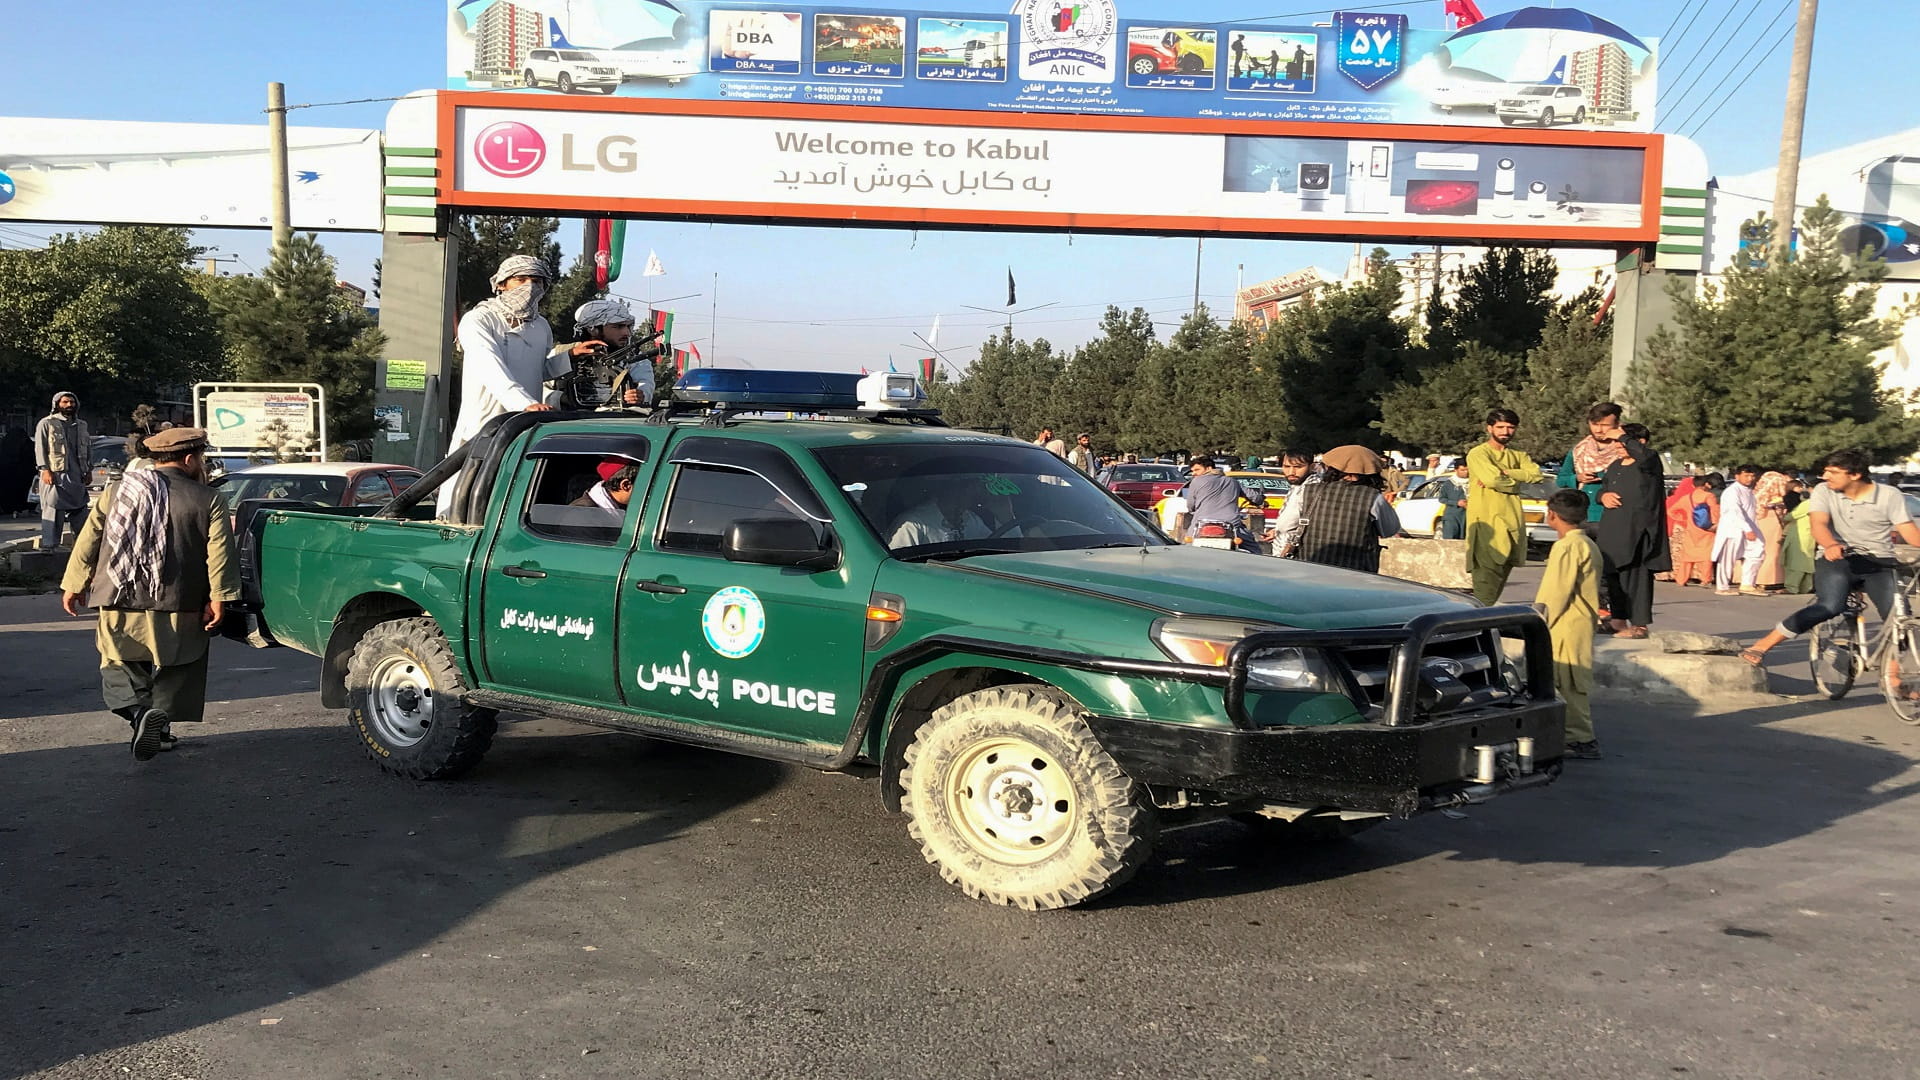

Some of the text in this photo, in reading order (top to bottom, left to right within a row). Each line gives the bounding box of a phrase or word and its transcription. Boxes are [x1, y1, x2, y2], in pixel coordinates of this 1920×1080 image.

[736, 32, 774, 44] DBA
[1350, 29, 1392, 54] ۵۷
[735, 60, 755, 69] DBA
[1346, 57, 1392, 68] سال خدمت
[828, 64, 890, 74] بیمه آتش سوزی
[927, 67, 997, 79] بیمه اموال تجارتی
[1049, 64, 1085, 76] ANIC
[1147, 76, 1194, 87] بیمه موتر
[1250, 81, 1294, 90] بیمه سفر
[1048, 85, 1064, 94] ملی
[1067, 86, 1084, 94] بیمه
[1086, 86, 1112, 96] شرکت
[775, 131, 1049, 161] Welcome to Kabul
[562, 133, 637, 173] LG
[773, 161, 1051, 198] به کابل خوش آمدید
[501, 608, 517, 629] کابل
[637, 650, 719, 709] پولیس
[732, 678, 836, 715] POLICE
[354, 708, 390, 757] DEESTONE
